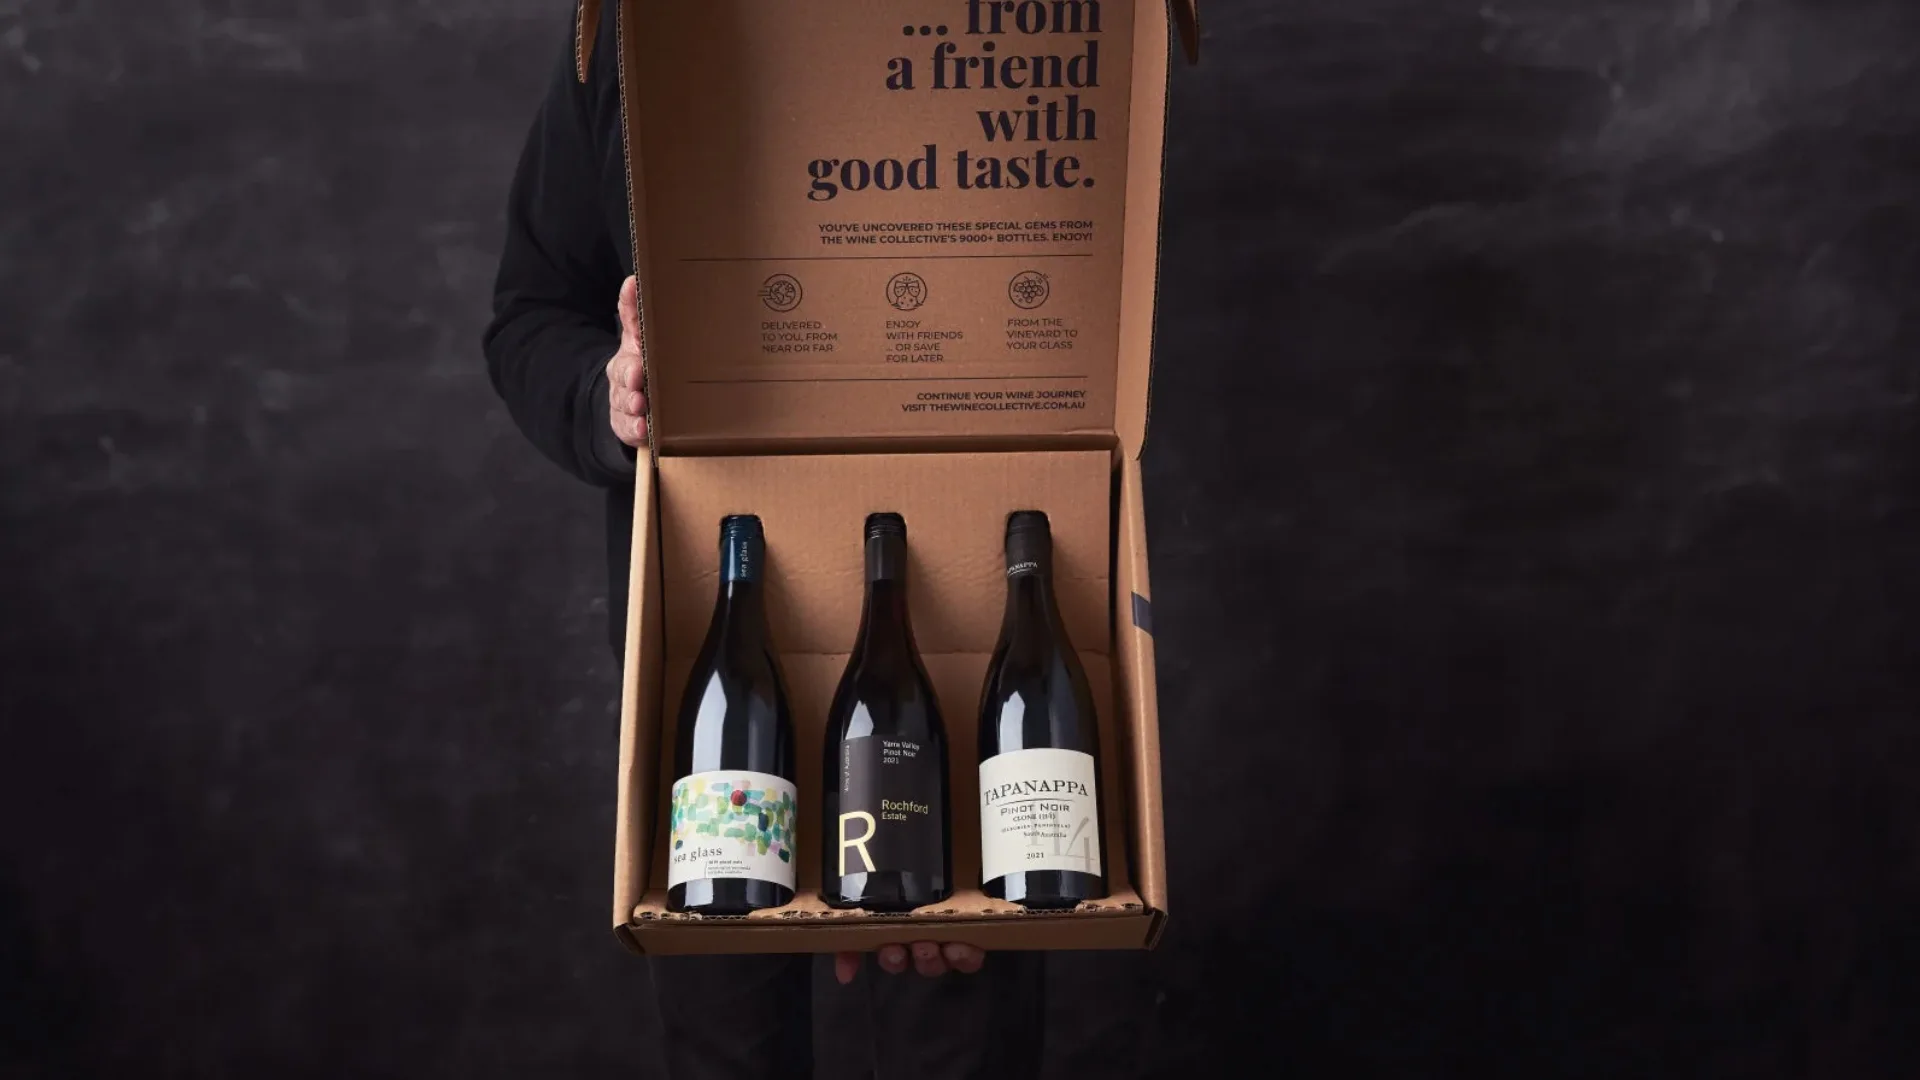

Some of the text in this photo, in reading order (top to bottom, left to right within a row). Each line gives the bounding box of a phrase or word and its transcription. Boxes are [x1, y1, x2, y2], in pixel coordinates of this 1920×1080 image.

[964, 0, 1102, 35] from
[886, 40, 1100, 90] a friend
[977, 94, 1098, 142] with
[807, 144, 1095, 201] good taste.
[819, 220, 1093, 232] YOU'VE UNCOVERED THESE SPECIAL GEMS FROM
[820, 232, 1093, 245] THE WINE COLLECTIVE'S 9000+ BOTTLES. ENJOY!
[761, 321, 821, 330] DELIVERED
[886, 321, 921, 329] ENJOY
[1007, 318, 1063, 327] FROM THE
[762, 332, 838, 342] TO YOU, FROM
[886, 332, 963, 341] WITH FRIENDS
[1007, 329, 1078, 339] VINEYARD TO
[762, 343, 834, 353] NEAR OR FAR
[895, 343, 911, 352] OR
[914, 343, 941, 351] SAVE
[1006, 340, 1073, 350] YOUR GLASS
[886, 354, 944, 363] FOR LATER
[917, 390, 1087, 400] CONTINUE YOUR WINE JOURNEY
[902, 401, 1085, 412] VISIT THEWINECOLLECTIVE.COM.AU
[984, 779, 1089, 806] TAPANAPPA
[882, 799, 928, 814] Rochford
[1000, 802, 1070, 816] PINOT NOIR
[838, 810, 876, 877] R
[690, 847, 722, 862] glass
[1026, 852, 1044, 860] 2021
